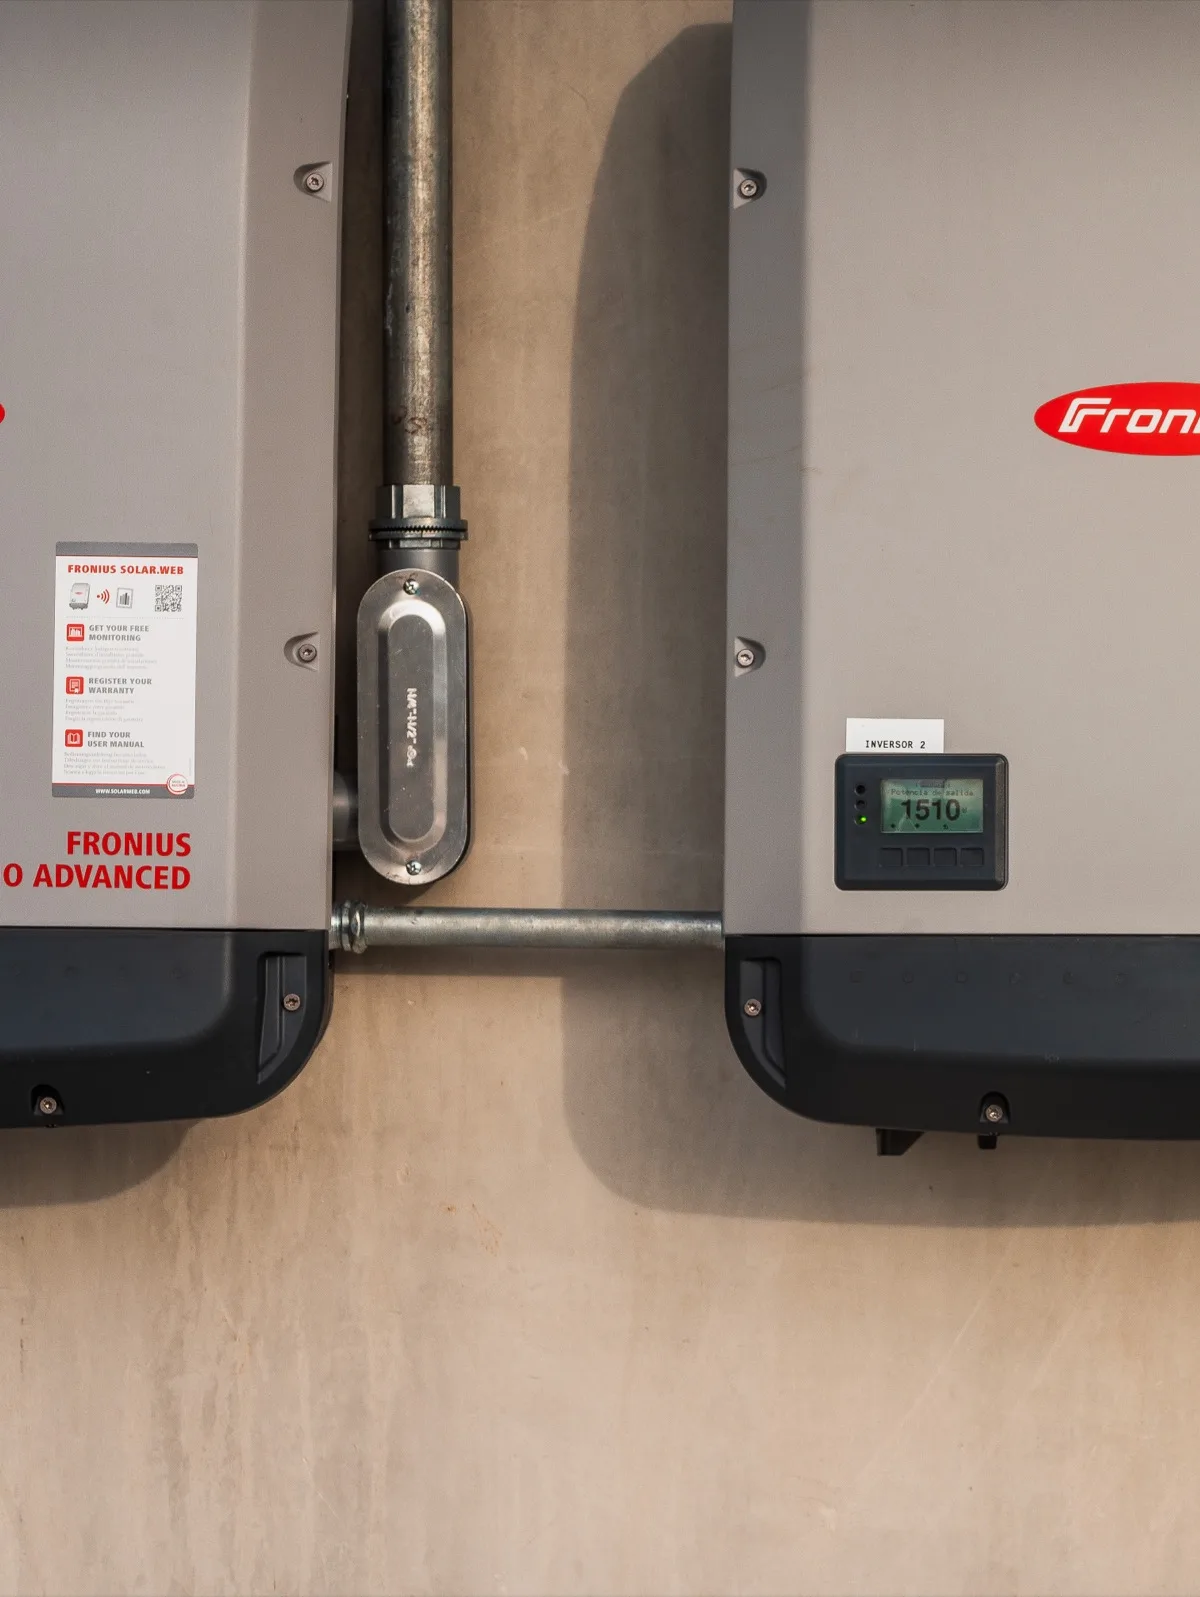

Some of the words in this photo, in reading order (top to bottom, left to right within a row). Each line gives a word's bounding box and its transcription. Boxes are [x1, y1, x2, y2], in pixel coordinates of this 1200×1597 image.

[68, 564, 116, 574] FRONIUS
[120, 565, 184, 574] SOLAR.WEB
[865, 740, 913, 749] INVERSOR
[920, 740, 926, 749] 2
[901, 798, 960, 821] 1510
[67, 831, 192, 857] FRONIUS
[3, 863, 23, 888] O
[32, 864, 191, 890] ADVANCED
